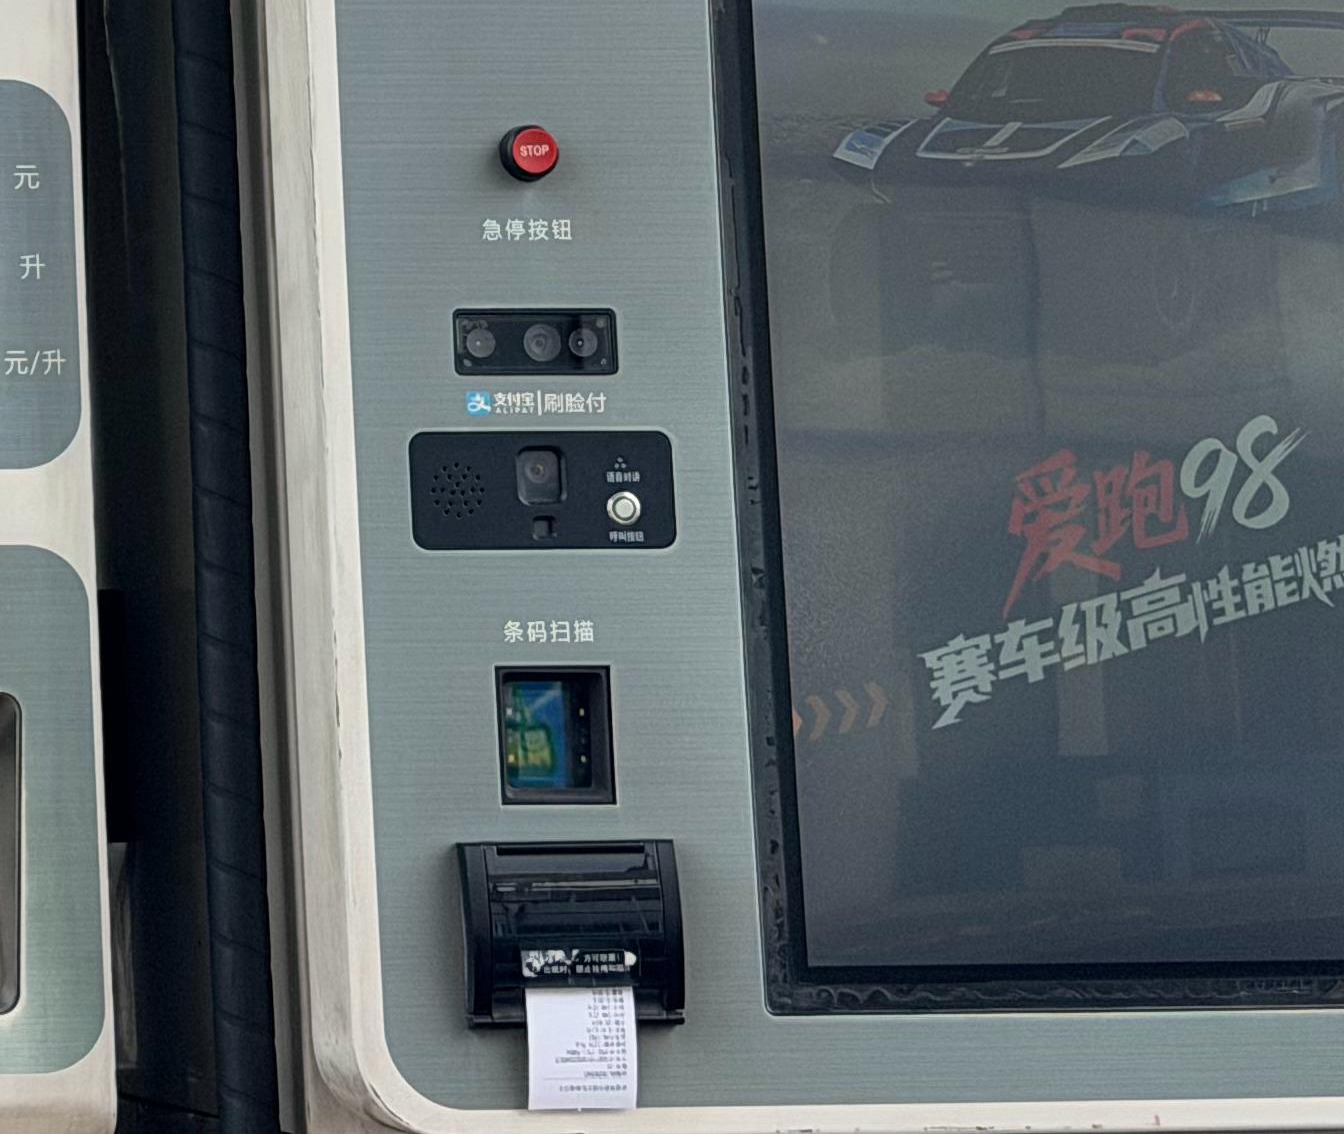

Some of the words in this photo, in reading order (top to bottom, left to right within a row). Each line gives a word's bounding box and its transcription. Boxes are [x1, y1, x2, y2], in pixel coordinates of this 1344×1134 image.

[519, 144, 550, 157] STOP
[13, 165, 41, 191] 元
[481, 218, 573, 242] 急停按钮
[19, 254, 46, 280] 升
[3, 349, 67, 376] 元/升
[493, 391, 535, 407] 支付宝
[543, 392, 607, 414] 刷脸付
[1003, 413, 1312, 621] 爱跑98
[503, 620, 595, 643] 条码扫描
